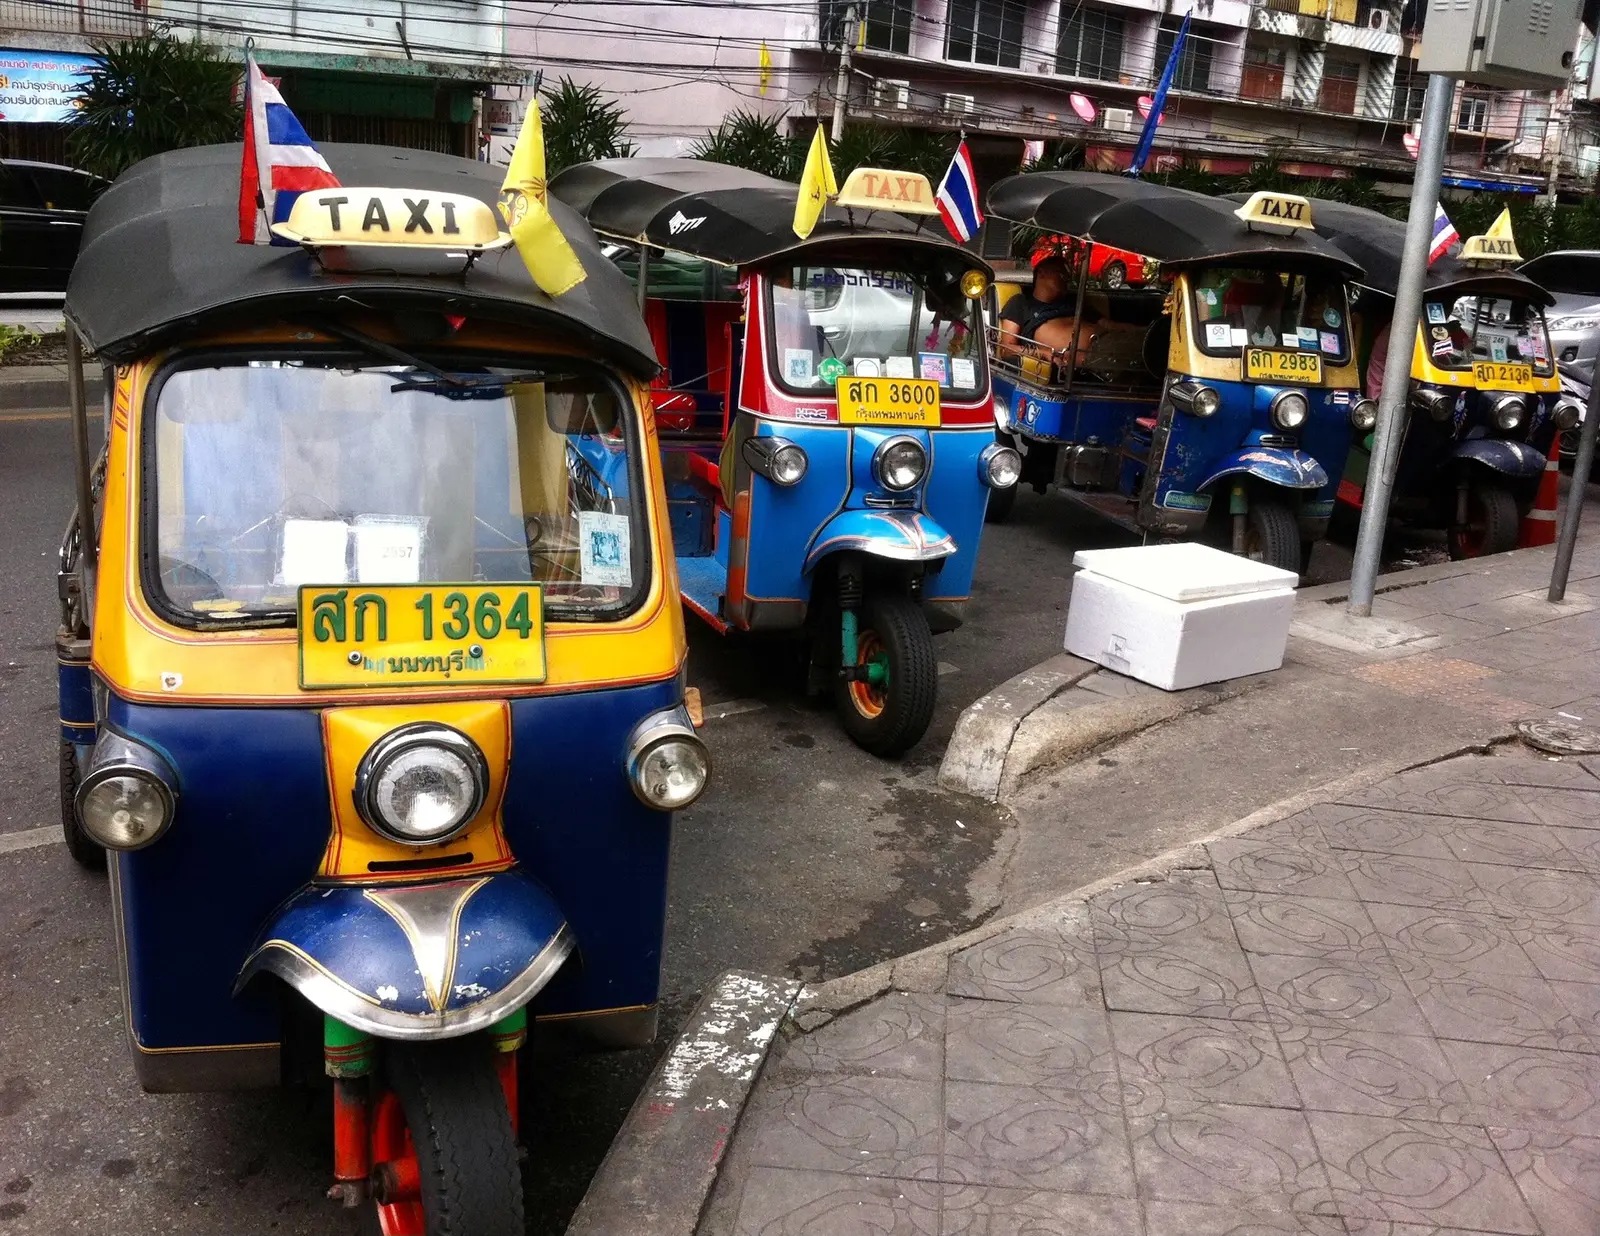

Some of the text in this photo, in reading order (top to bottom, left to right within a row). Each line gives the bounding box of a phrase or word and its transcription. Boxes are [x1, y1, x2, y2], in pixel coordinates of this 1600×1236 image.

[863, 173, 924, 203] TAXI
[318, 196, 461, 235] TAXI
[1261, 198, 1305, 221] TAXI
[1478, 238, 1513, 255] TAXI
[1279, 353, 1318, 372] 2983
[849, 380, 936, 406] สก 3600
[312, 589, 533, 642] สก 1364
[387, 649, 464, 678] นนทบุรี
